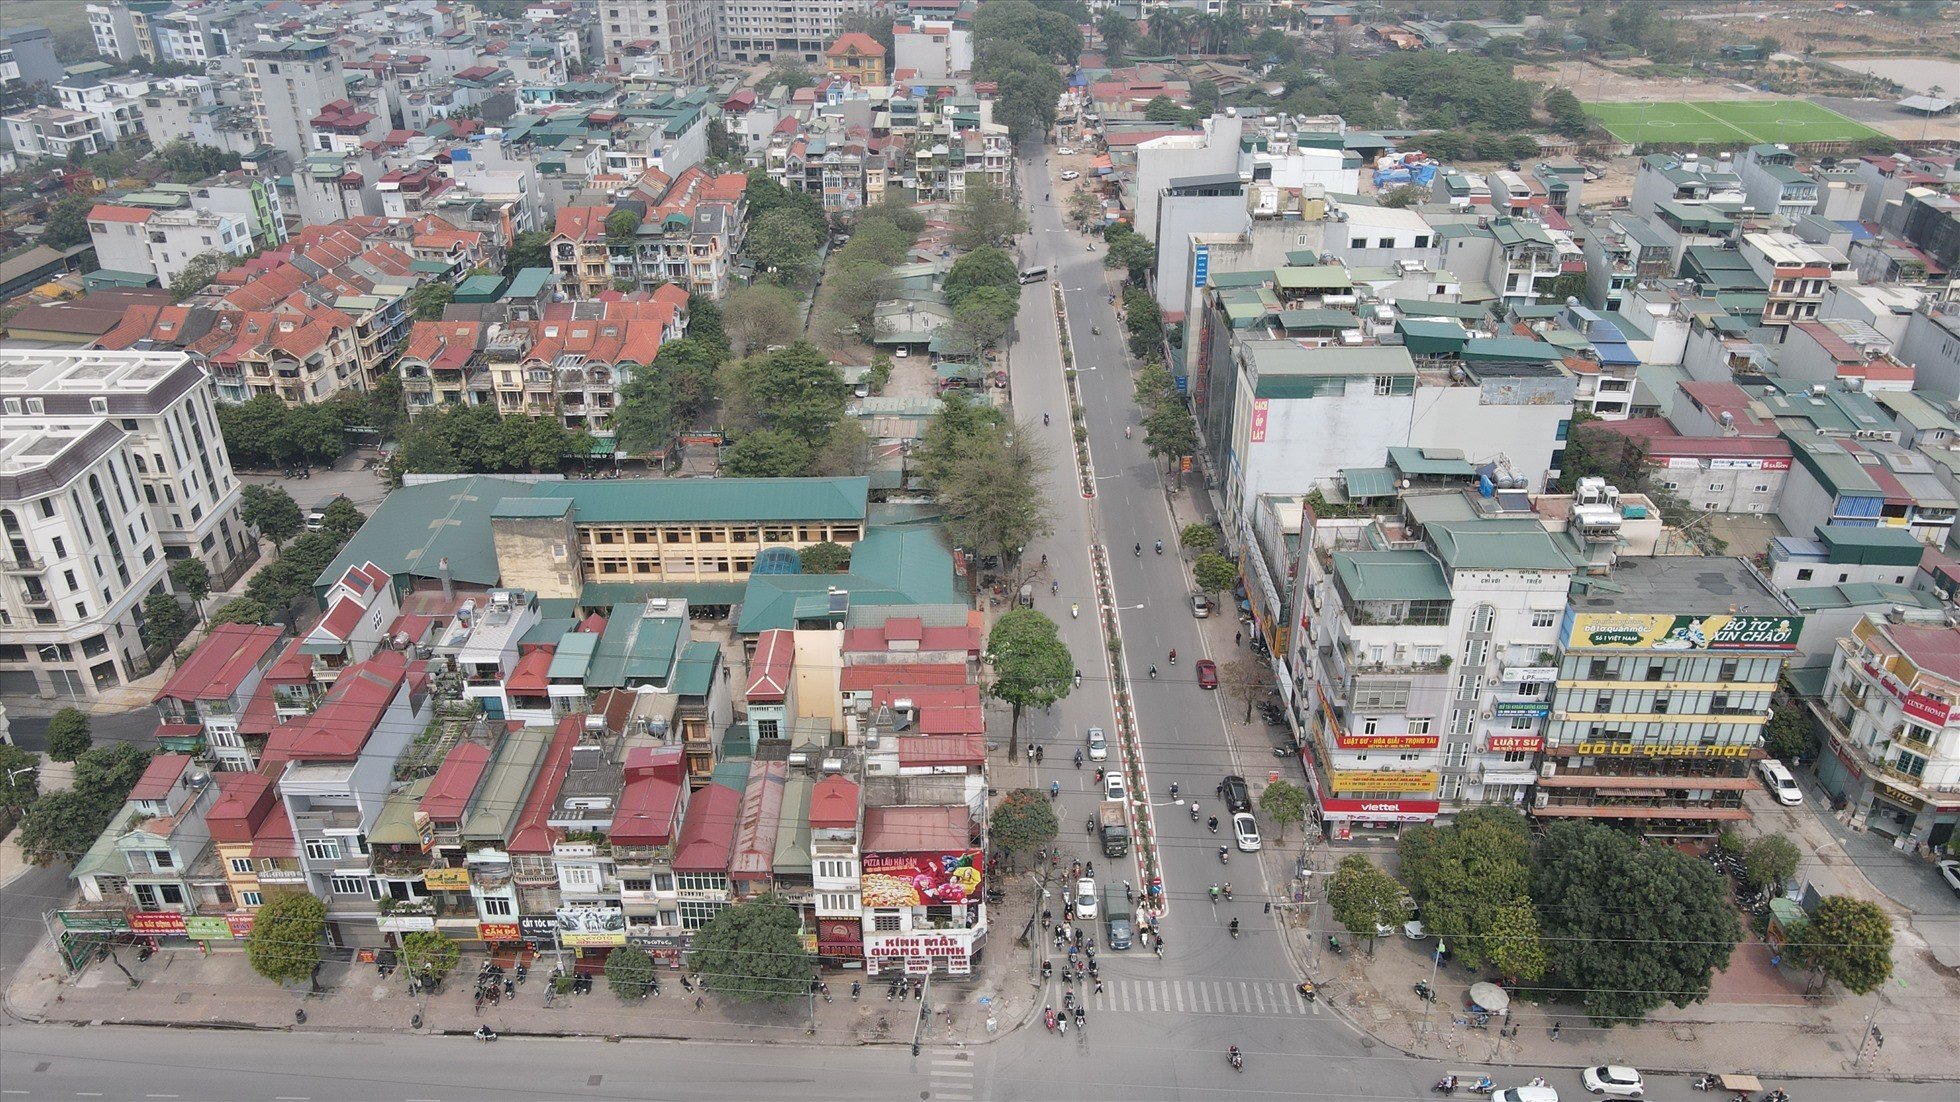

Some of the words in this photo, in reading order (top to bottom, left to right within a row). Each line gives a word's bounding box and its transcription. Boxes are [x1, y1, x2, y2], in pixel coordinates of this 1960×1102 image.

[1723, 619, 1747, 631] BÒ
[1749, 621, 1773, 631] TƠ
[1711, 631, 1739, 641] XIN
[1741, 629, 1792, 642] CHÀO!
[1907, 699, 1924, 710] LUXE
[1924, 706, 1946, 718] HOME
[1493, 737, 1520, 746] LUẬT
[1523, 738, 1540, 746] SƯ
[1361, 803, 1400, 811] viettel
[863, 859, 880, 867] PIZZA
[885, 937, 920, 947] KÍNH
[924, 935, 956, 946] MẮT
[871, 947, 920, 956] QUANG
[925, 947, 965, 956] MINH
